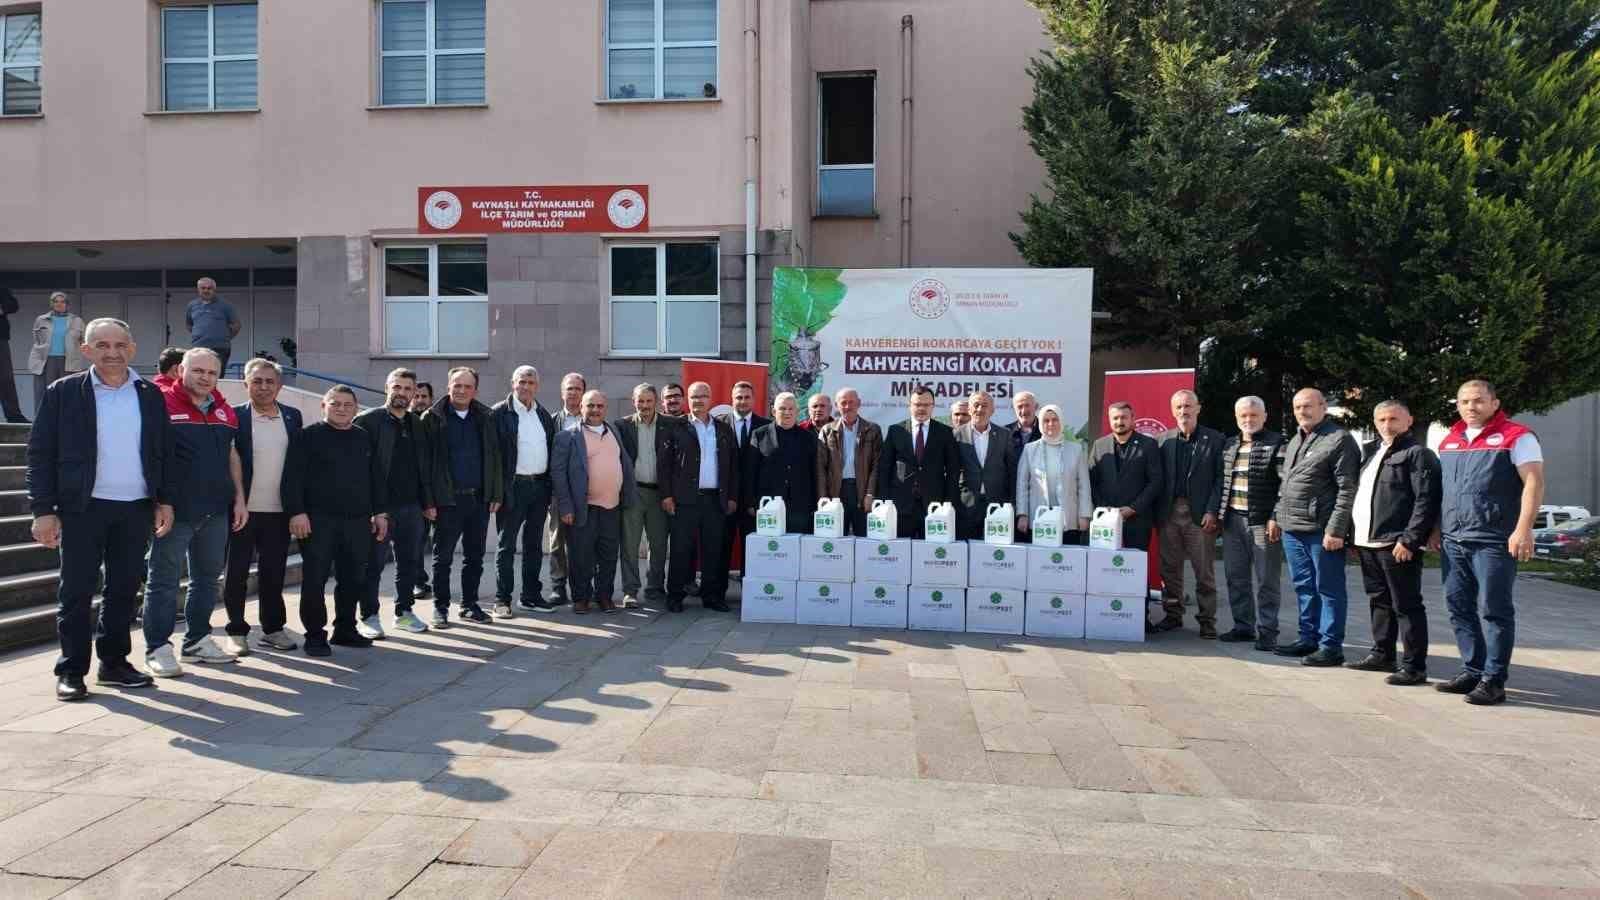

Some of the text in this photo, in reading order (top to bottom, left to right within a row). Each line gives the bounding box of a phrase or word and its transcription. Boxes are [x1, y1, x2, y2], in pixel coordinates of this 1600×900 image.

[524, 191, 542, 199] T.C.
[472, 199, 594, 210] KAYNAŞLI KAYMAKAMLIĞI
[504, 210, 534, 218] TARIM
[550, 210, 586, 218] ORMAN
[502, 218, 565, 228] MÜDÜRLÜĞÜ
[846, 337, 920, 349] KAHVERENGİ
[923, 339, 992, 349] KOKARCAYA
[994, 337, 1028, 351] GEÇİT
[1031, 340, 1056, 350] YOK
[849, 353, 1057, 373] KAHVERENGİ KOKARCA
